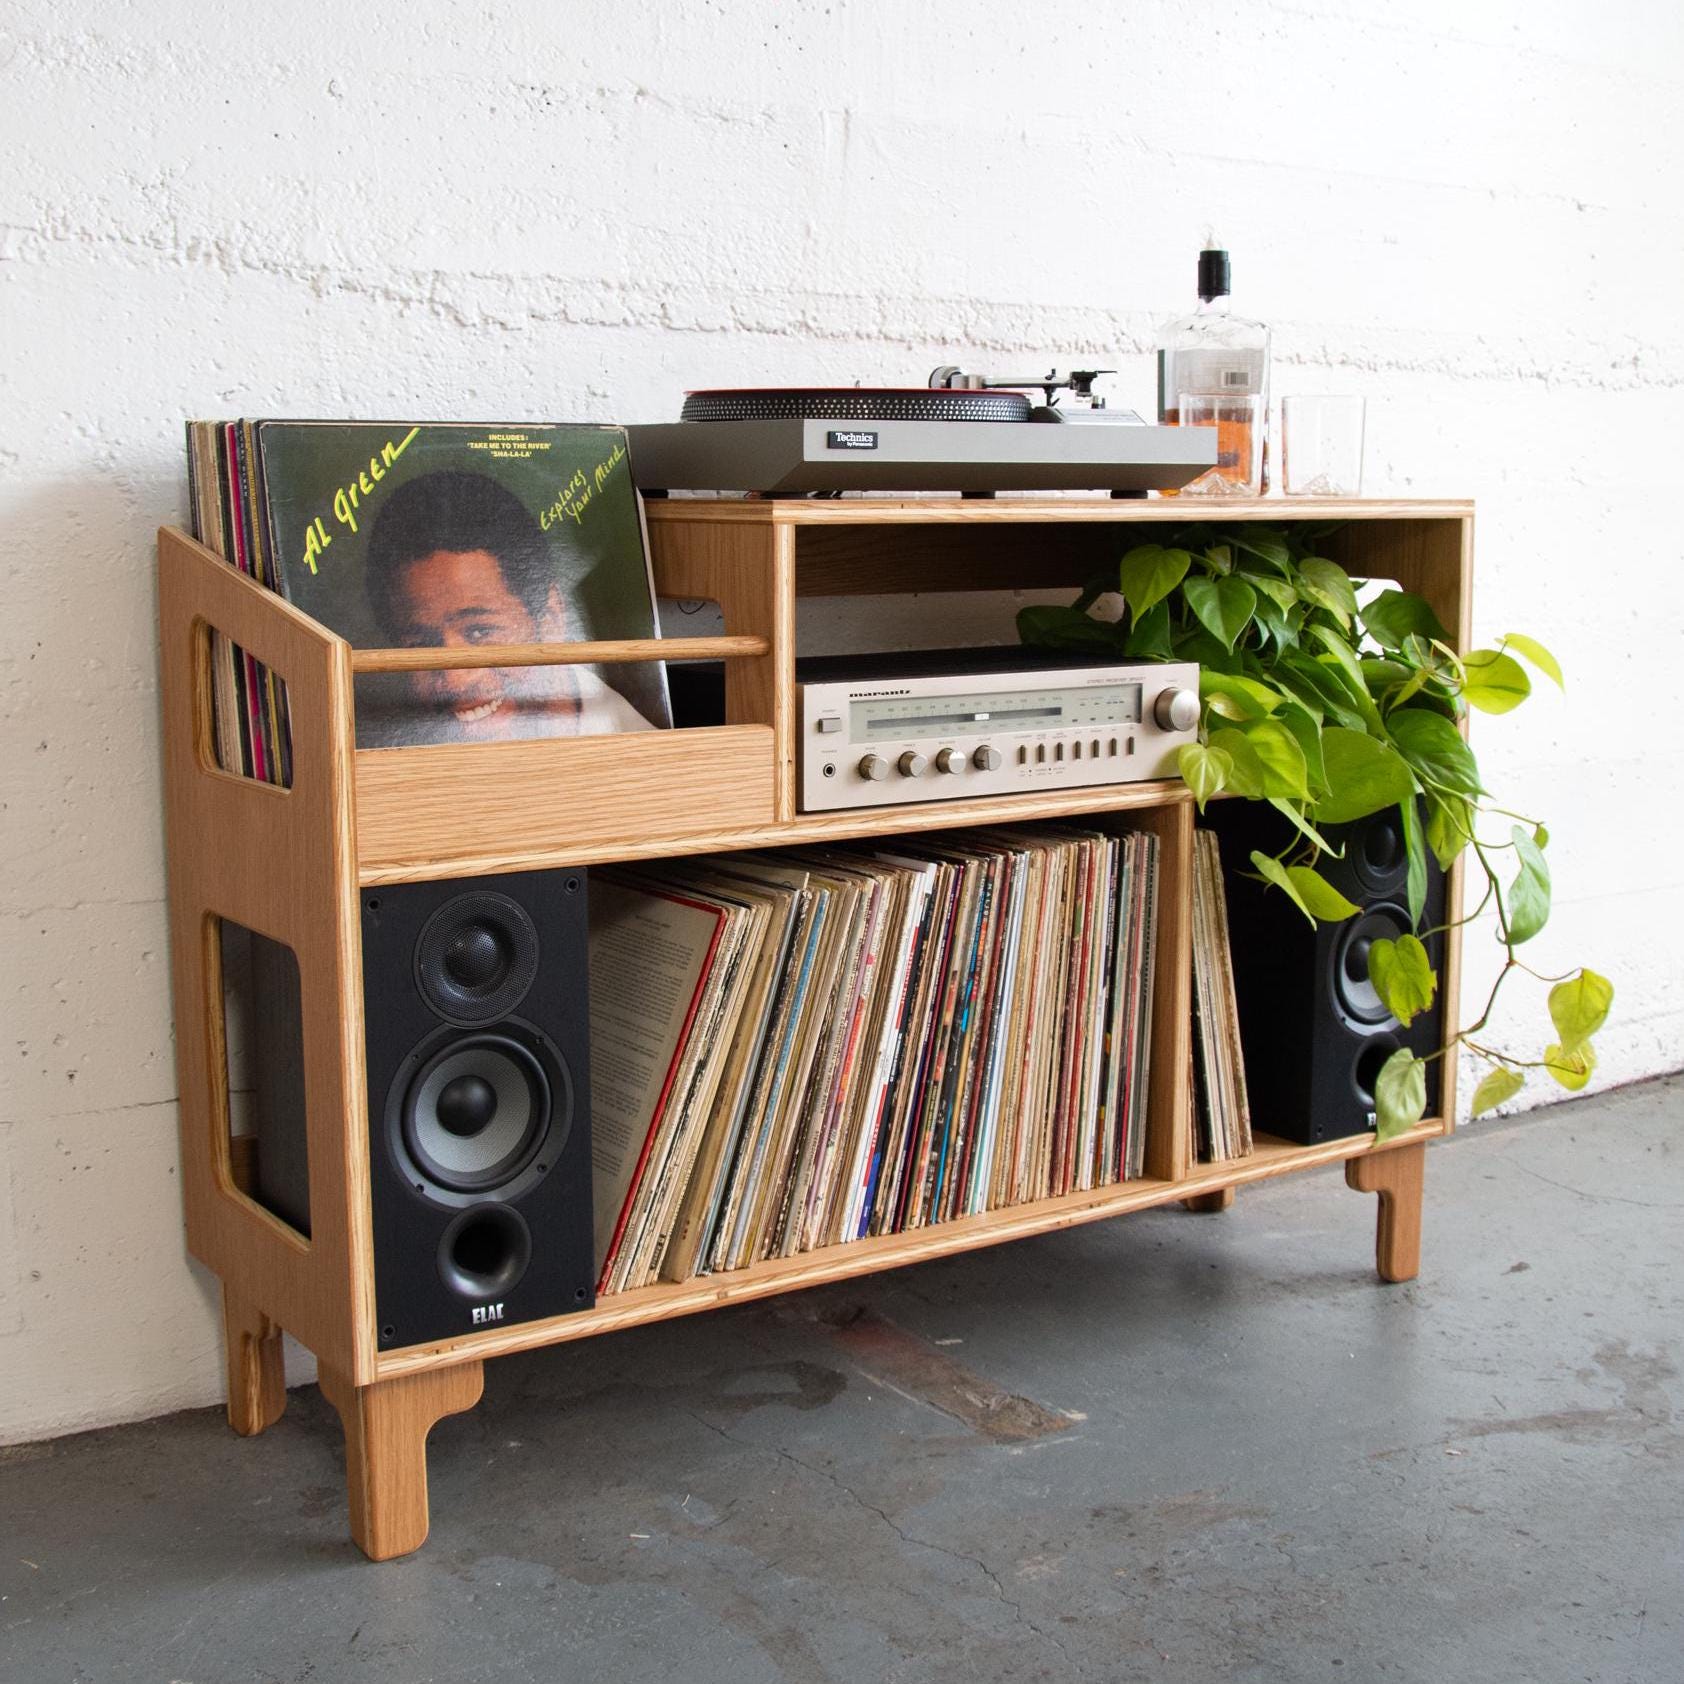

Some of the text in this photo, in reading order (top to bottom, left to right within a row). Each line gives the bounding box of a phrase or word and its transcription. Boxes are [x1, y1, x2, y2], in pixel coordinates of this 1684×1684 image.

[835, 432, 873, 442] Technics
[565, 445, 625, 525] Your Mind
[539, 469, 587, 531] Explores
[849, 689, 911, 698] marantz
[472, 1303, 504, 1325] ELAC
